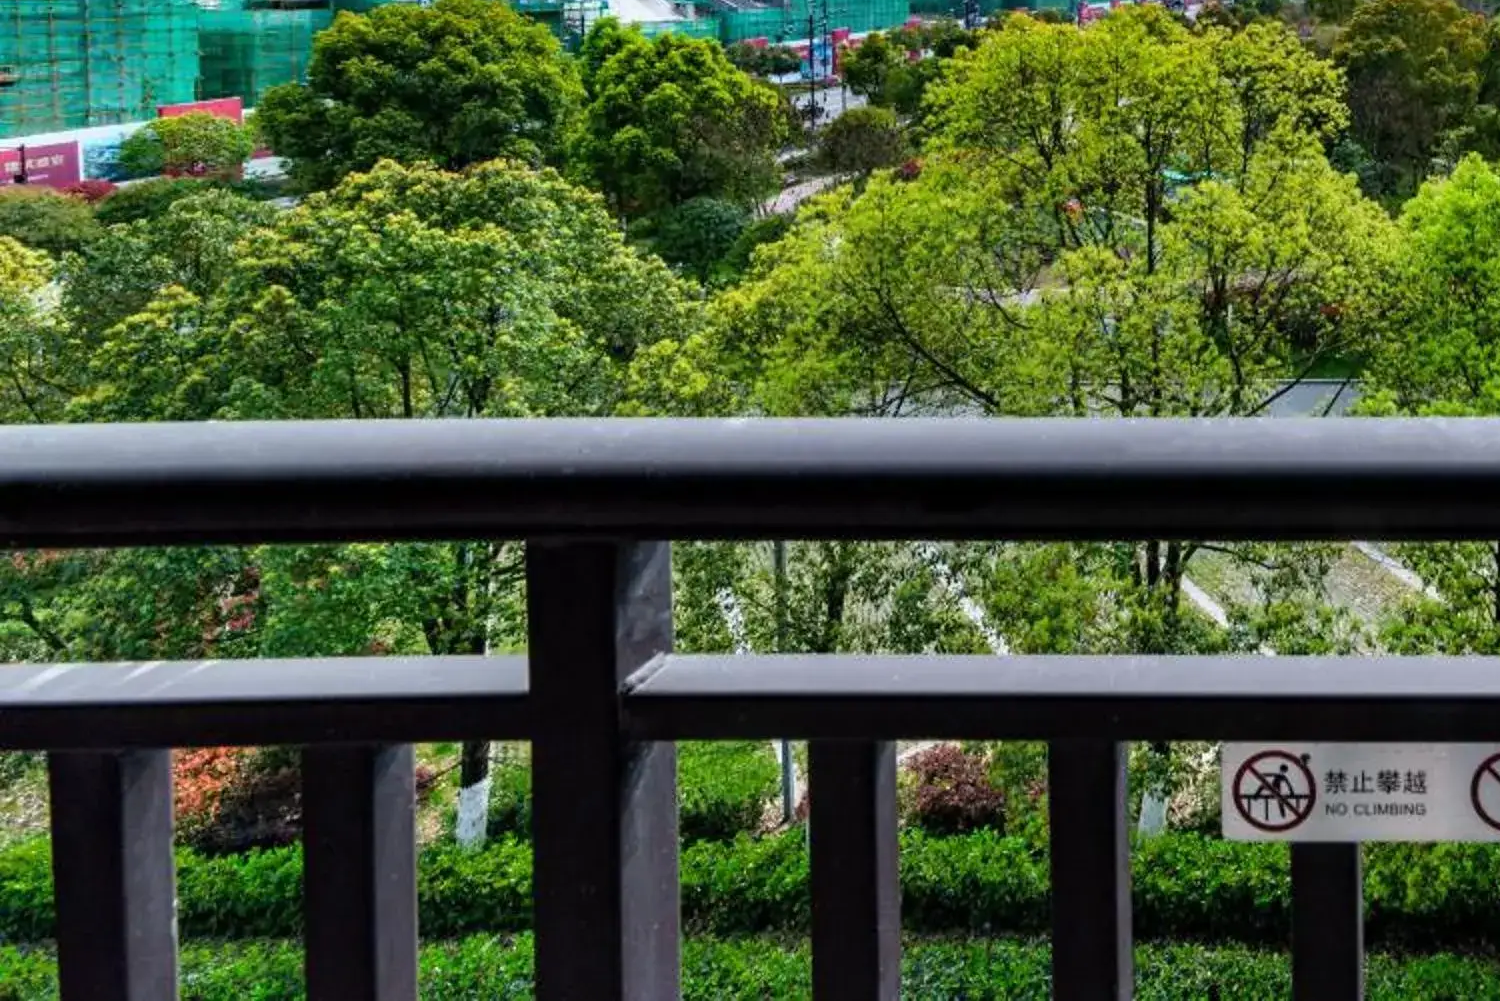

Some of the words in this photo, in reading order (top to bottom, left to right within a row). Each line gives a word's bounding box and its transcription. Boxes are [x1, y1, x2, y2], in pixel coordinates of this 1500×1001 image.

[1323, 768, 1427, 795] 禁止攀越
[1325, 802, 1348, 817] NO
[1353, 802, 1427, 817] CLIMBING
